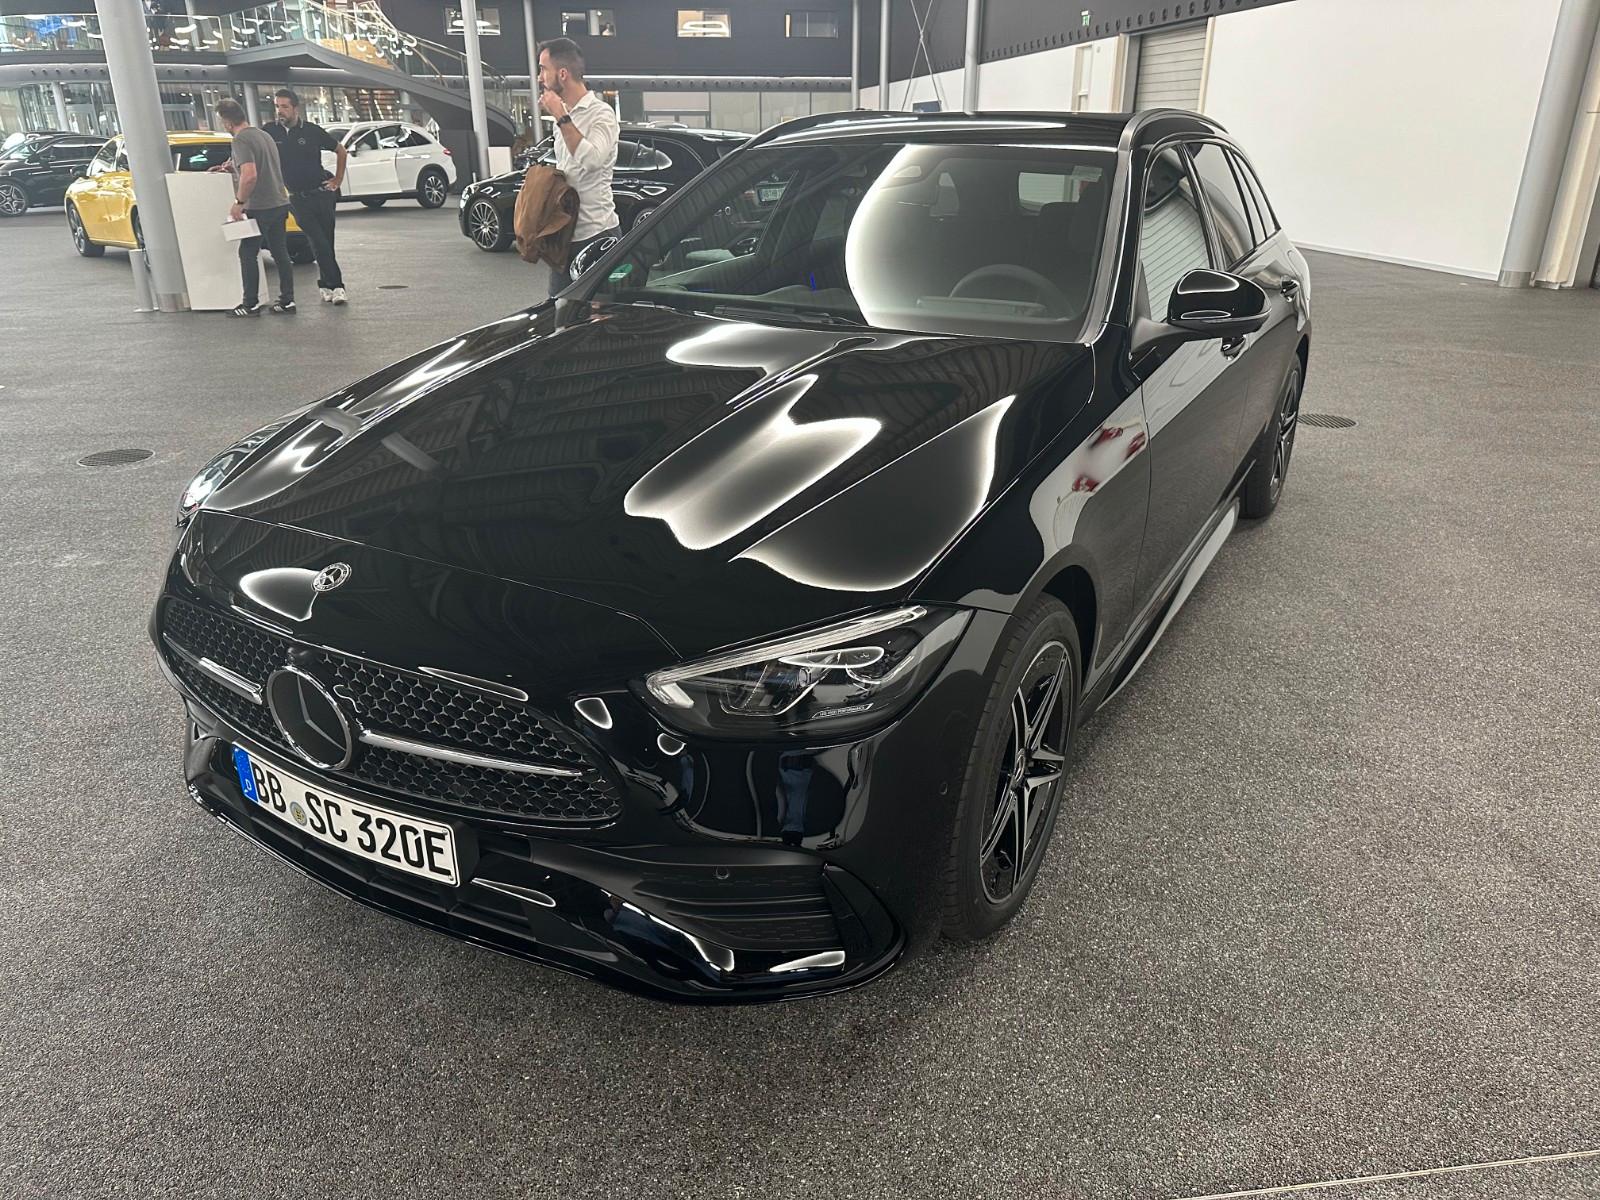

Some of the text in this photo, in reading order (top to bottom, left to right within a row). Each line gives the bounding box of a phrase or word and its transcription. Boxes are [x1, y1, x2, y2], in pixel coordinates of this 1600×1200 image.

[245, 779, 252, 791] D
[251, 762, 452, 876] BB SC 320E
